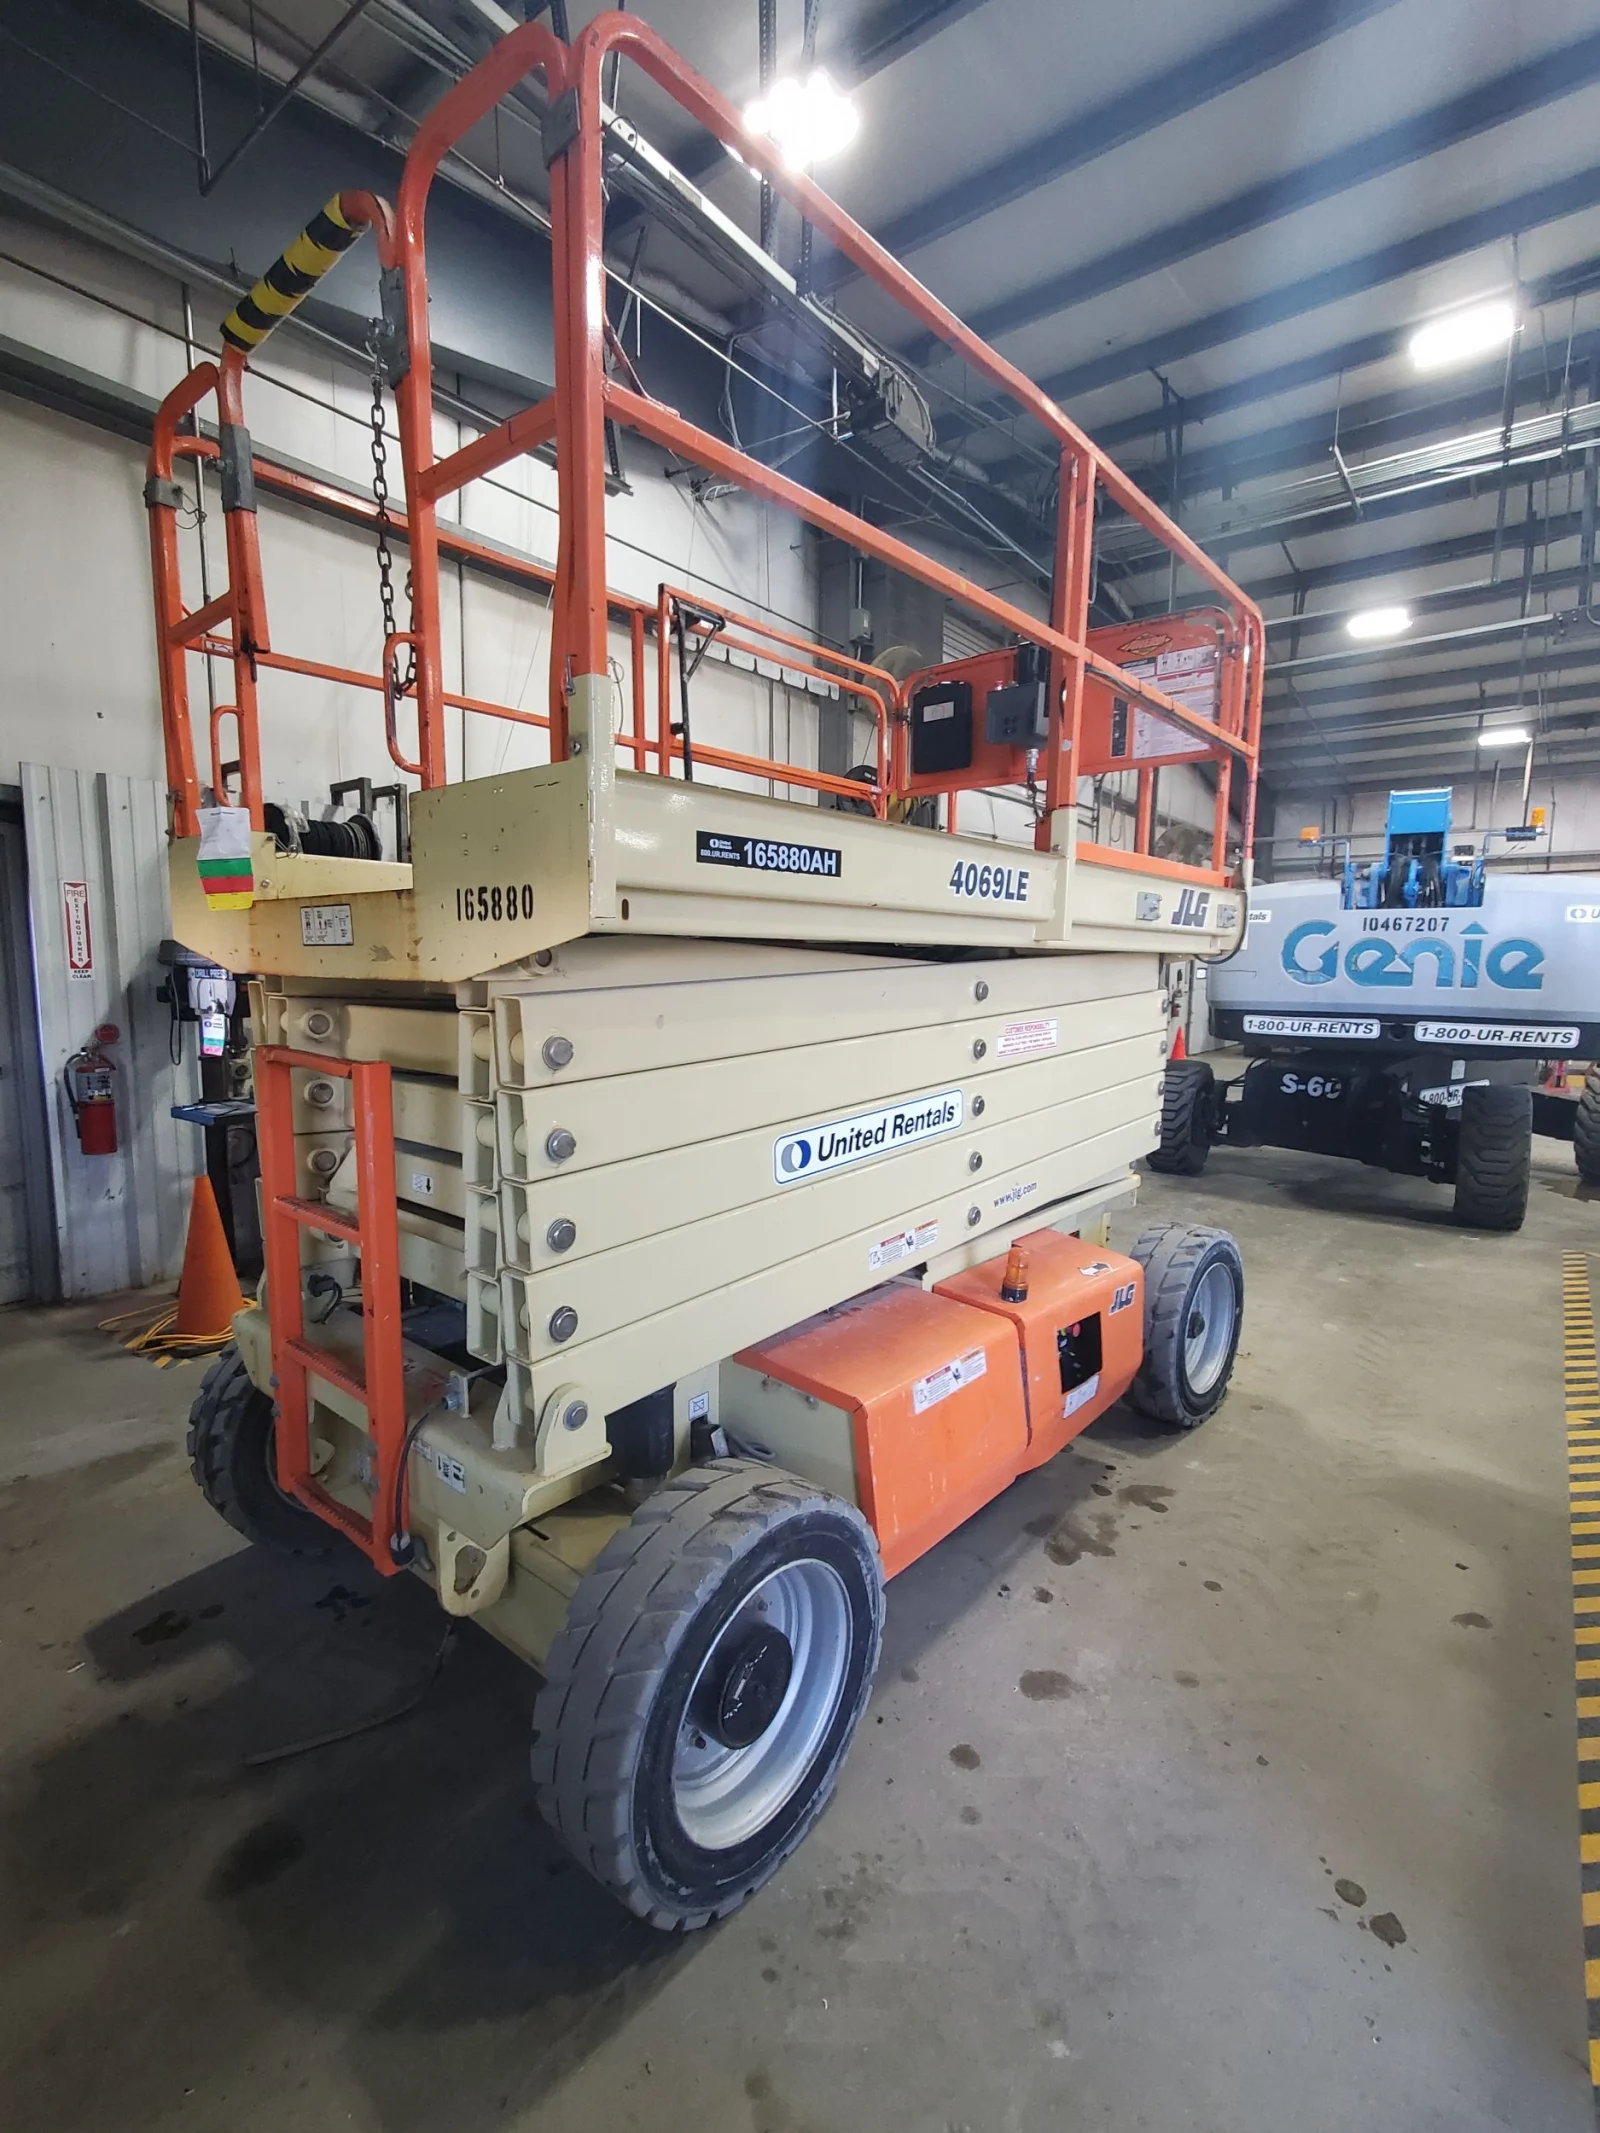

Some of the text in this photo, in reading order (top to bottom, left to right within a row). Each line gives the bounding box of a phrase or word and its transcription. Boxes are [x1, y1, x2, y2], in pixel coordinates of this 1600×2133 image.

[744, 841, 837, 874] 165880AH
[65, 889, 86, 898] FIRE
[949, 861, 1030, 901] 4069LE
[456, 883, 534, 921] 165880
[1170, 888, 1210, 928] JLG
[1249, 911, 1268, 921] tals
[74, 898, 84, 963] EXTINGUISHER
[1362, 916, 1450, 932] 10467207
[1281, 919, 1547, 990] Genie
[1246, 1018, 1375, 1036] 1-800-UR-RENTS
[1420, 1026, 1574, 1045] 1-800-UR-RENTS
[818, 1101, 955, 1162] United Rentals
[993, 1181, 1038, 1208] www.jlg.com
[1109, 1283, 1136, 1314] JLG
